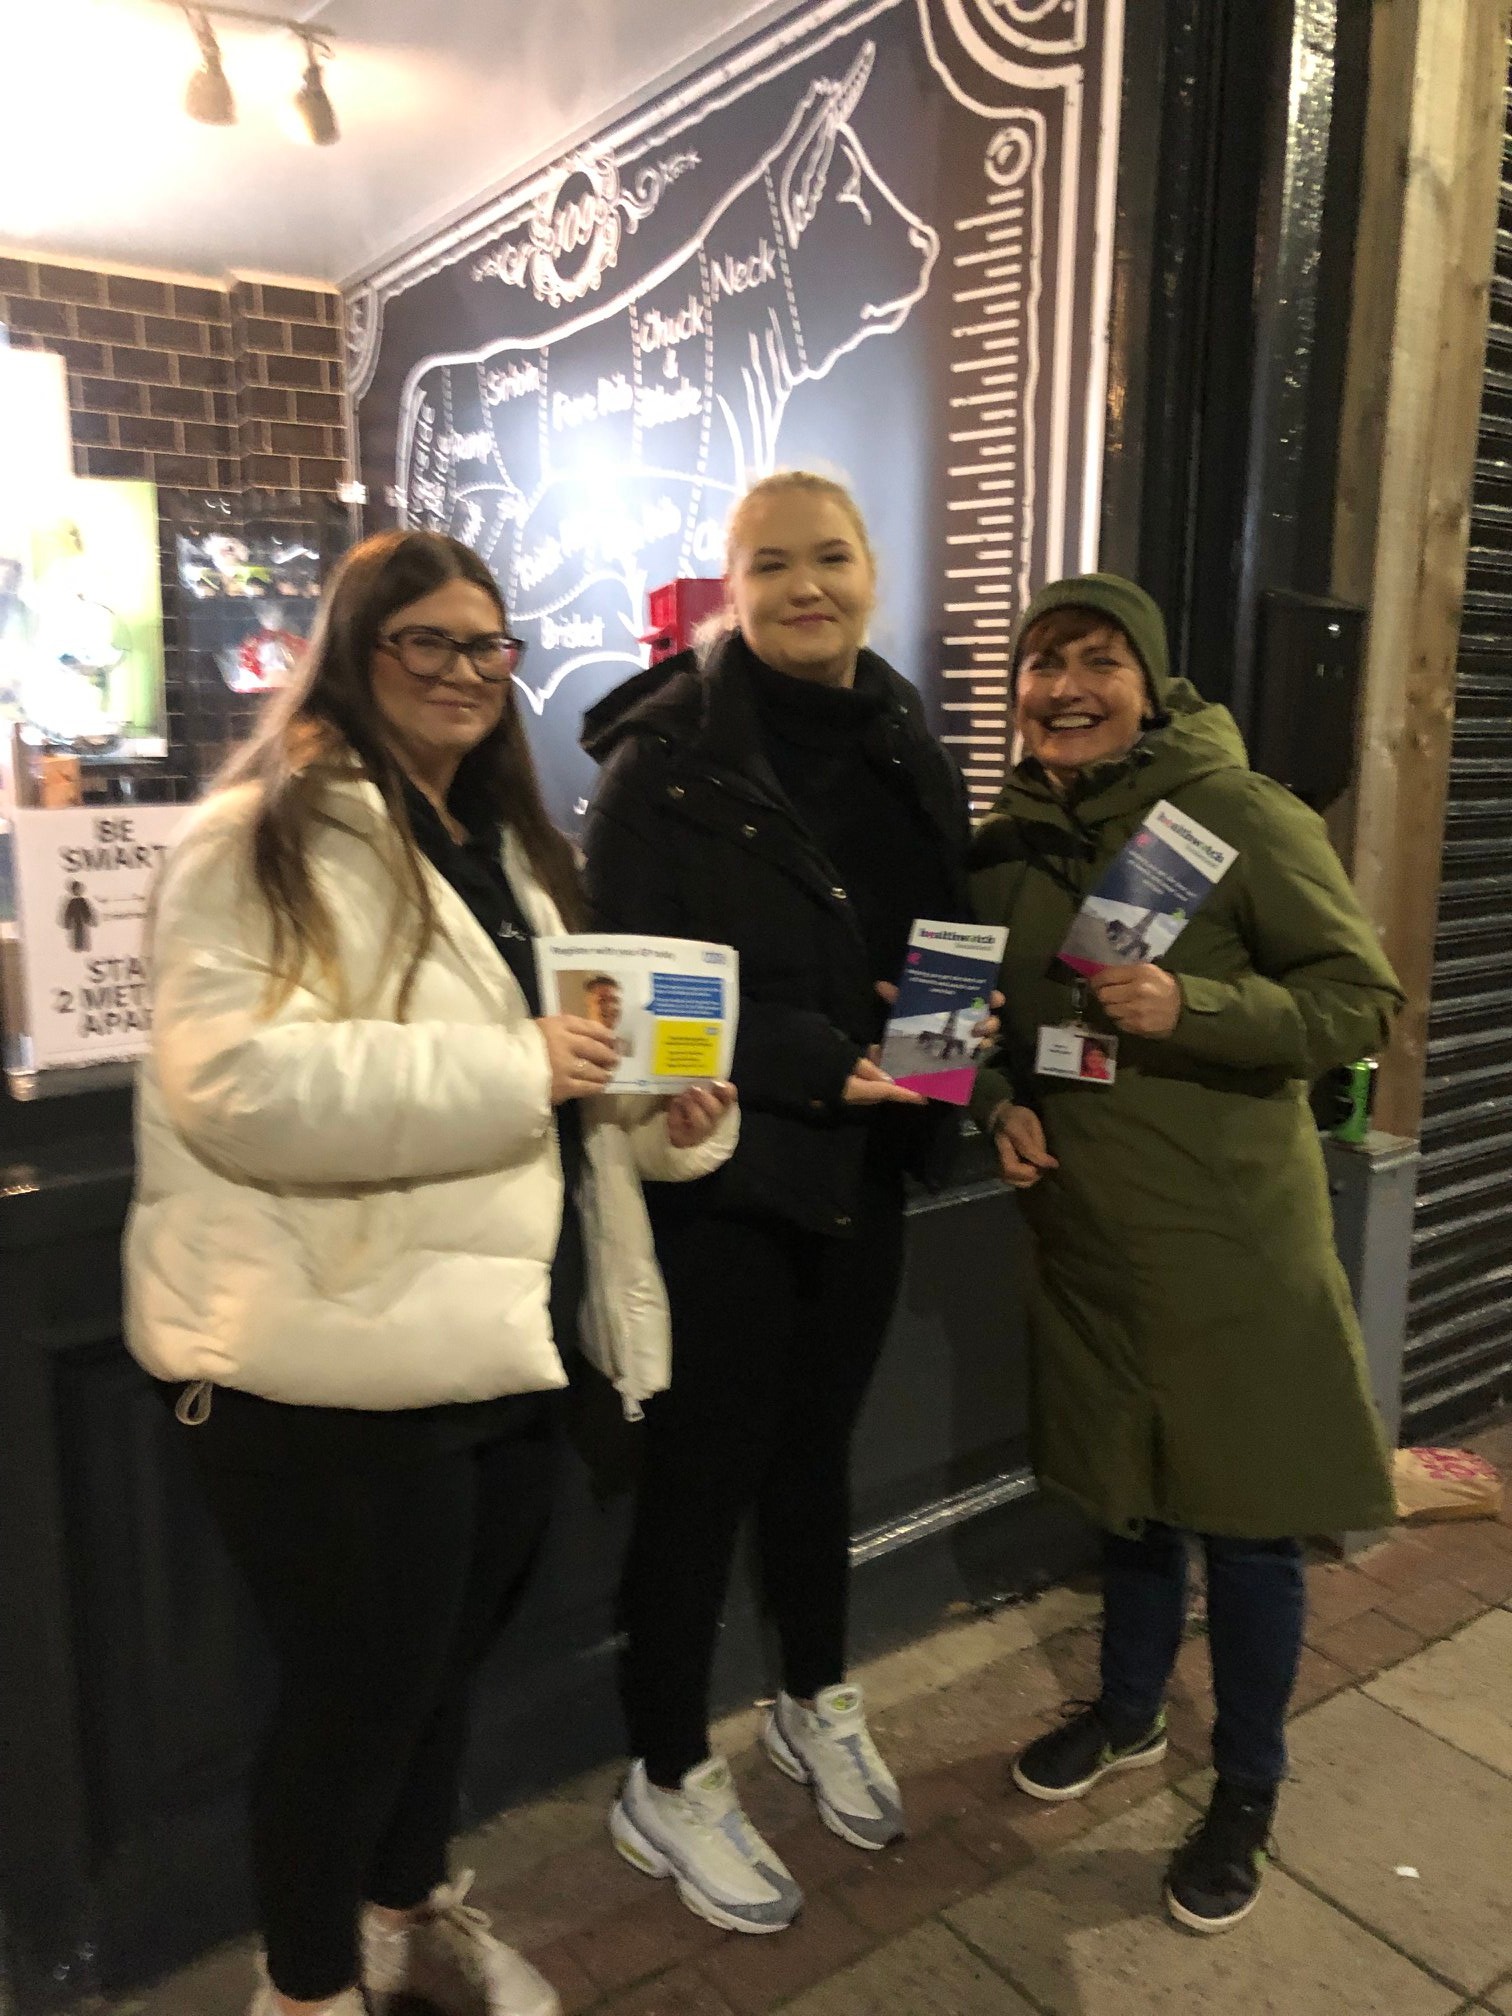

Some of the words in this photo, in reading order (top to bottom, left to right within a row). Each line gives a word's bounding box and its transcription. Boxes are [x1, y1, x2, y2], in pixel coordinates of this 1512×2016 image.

[711, 236, 776, 302] Neck
[639, 294, 704, 353] Chuck
[94, 817, 136, 843] BE
[58, 844, 168, 873] SMART
[84, 955, 151, 984] STA
[52, 988, 76, 1013] 2
[79, 982, 147, 1009] MET
